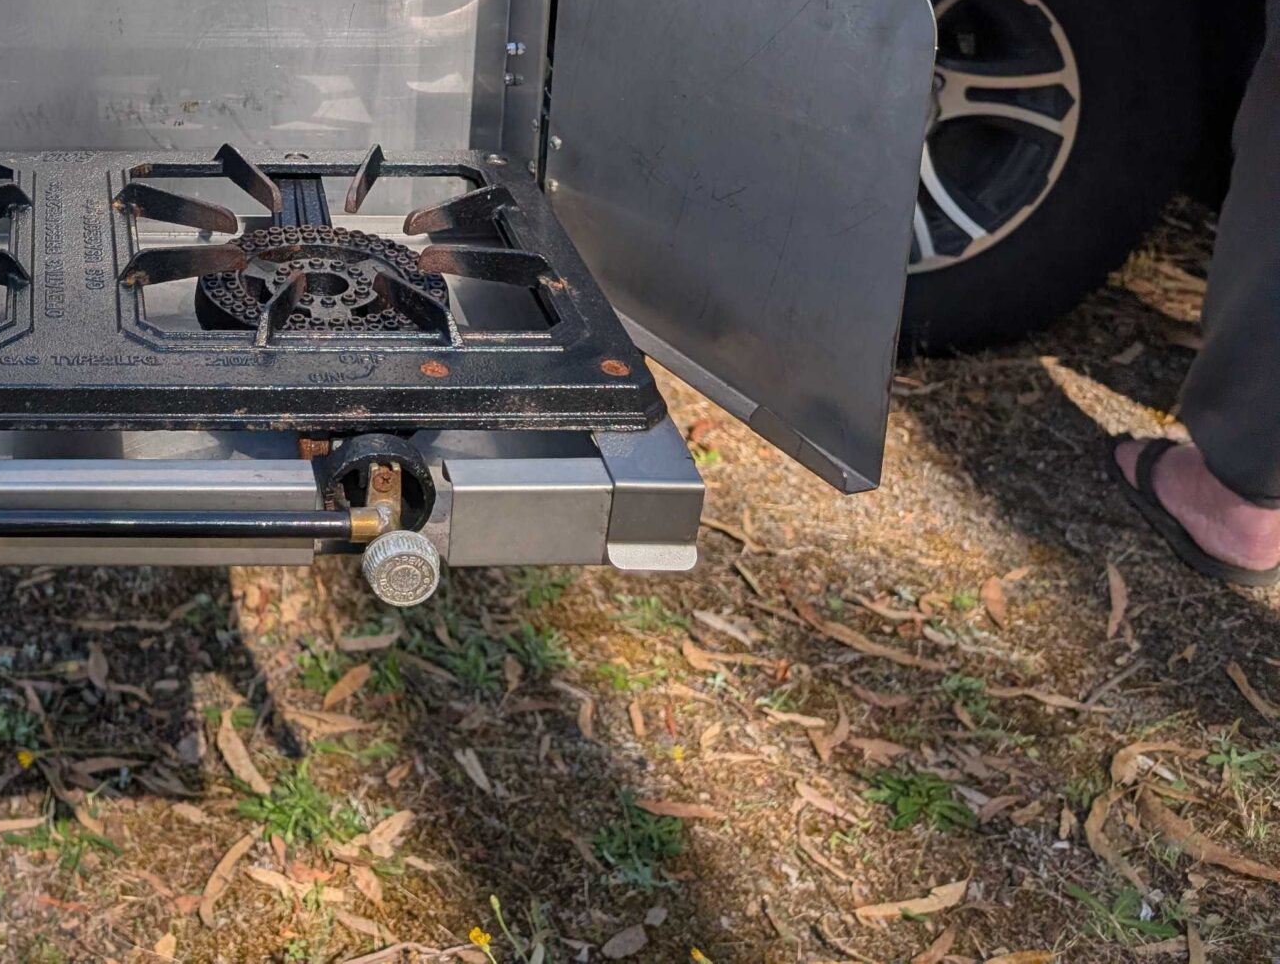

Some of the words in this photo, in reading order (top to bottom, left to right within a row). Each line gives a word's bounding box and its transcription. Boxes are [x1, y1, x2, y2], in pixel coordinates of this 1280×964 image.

[84, 267, 106, 291] GAS
[0, 354, 40, 366] GAS
[338, 352, 386, 365] OFF
[308, 371, 346, 384] ON
[394, 555, 424, 568] OPEN
